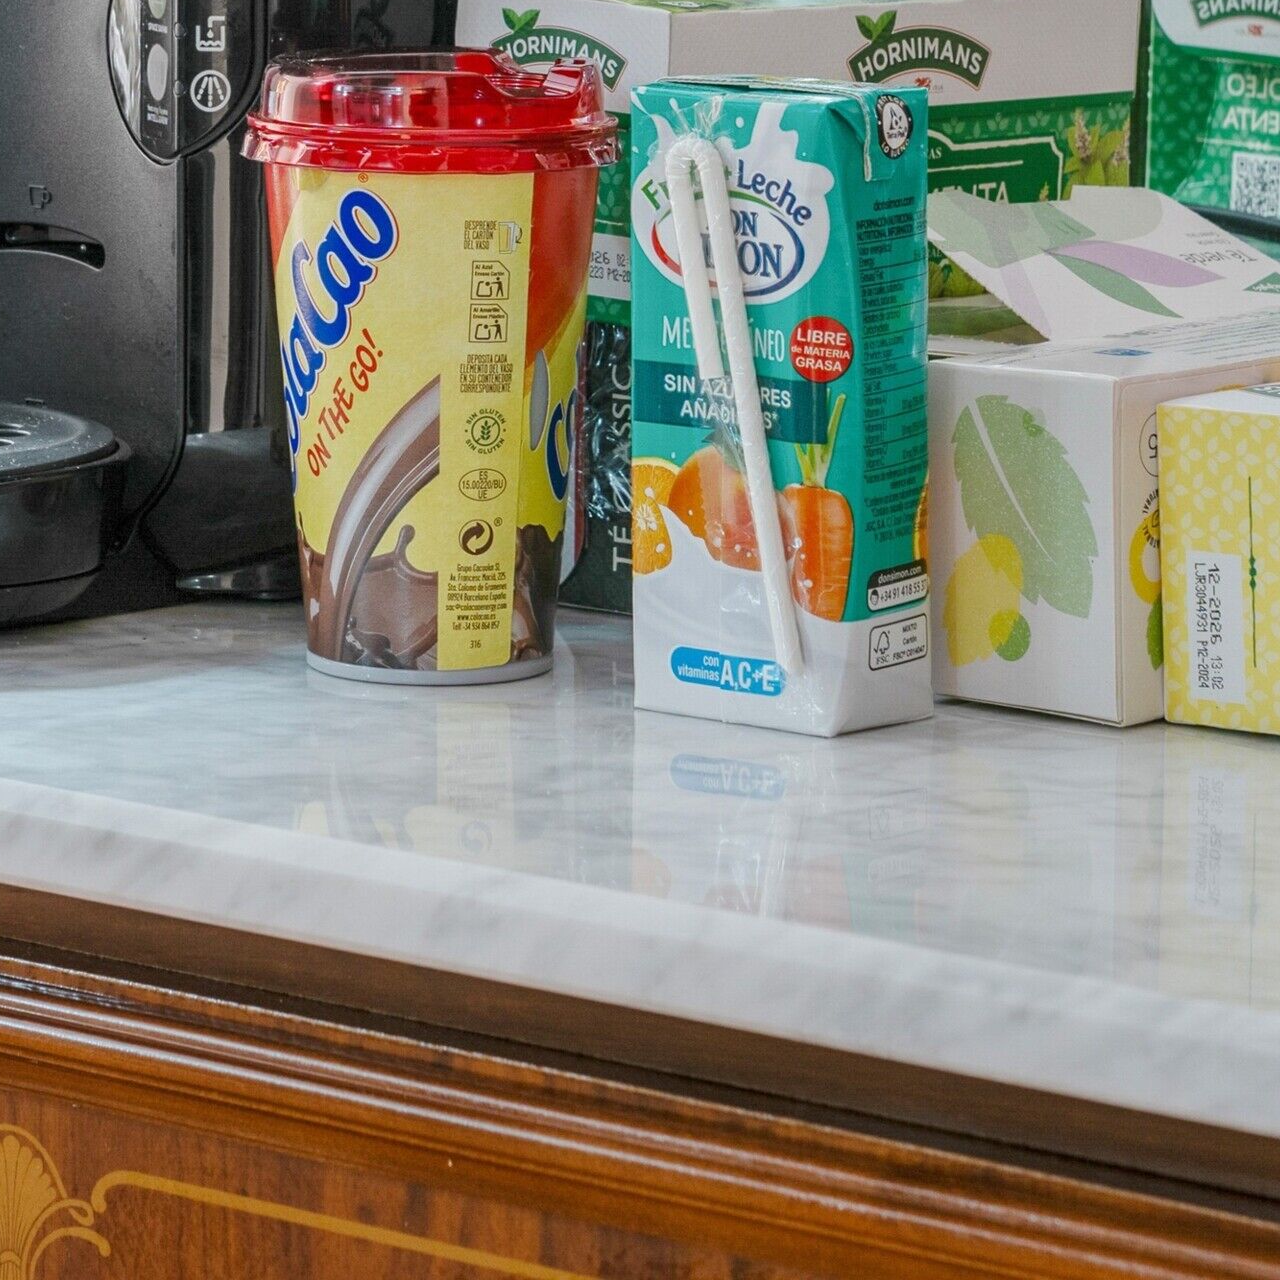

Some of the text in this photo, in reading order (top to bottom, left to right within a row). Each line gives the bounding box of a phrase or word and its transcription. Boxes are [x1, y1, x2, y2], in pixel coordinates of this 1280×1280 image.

[856, 35, 984, 81] HORNIMANS
[737, 159, 813, 227] Leche
[796, 329, 847, 346] LIBRE
[791, 345, 850, 360] de MATERIA
[795, 356, 843, 373] GRASA
[664, 374, 696, 393] SIN
[306, 328, 385, 477] ON THE GO!
[877, 566, 922, 584] donsimon.com
[1207, 563, 1223, 645] 12-2026
[469, 640, 482, 649] 316
[703, 655, 720, 667] con
[677, 664, 720, 682] vitaminas
[1210, 655, 1224, 690] 13:02
